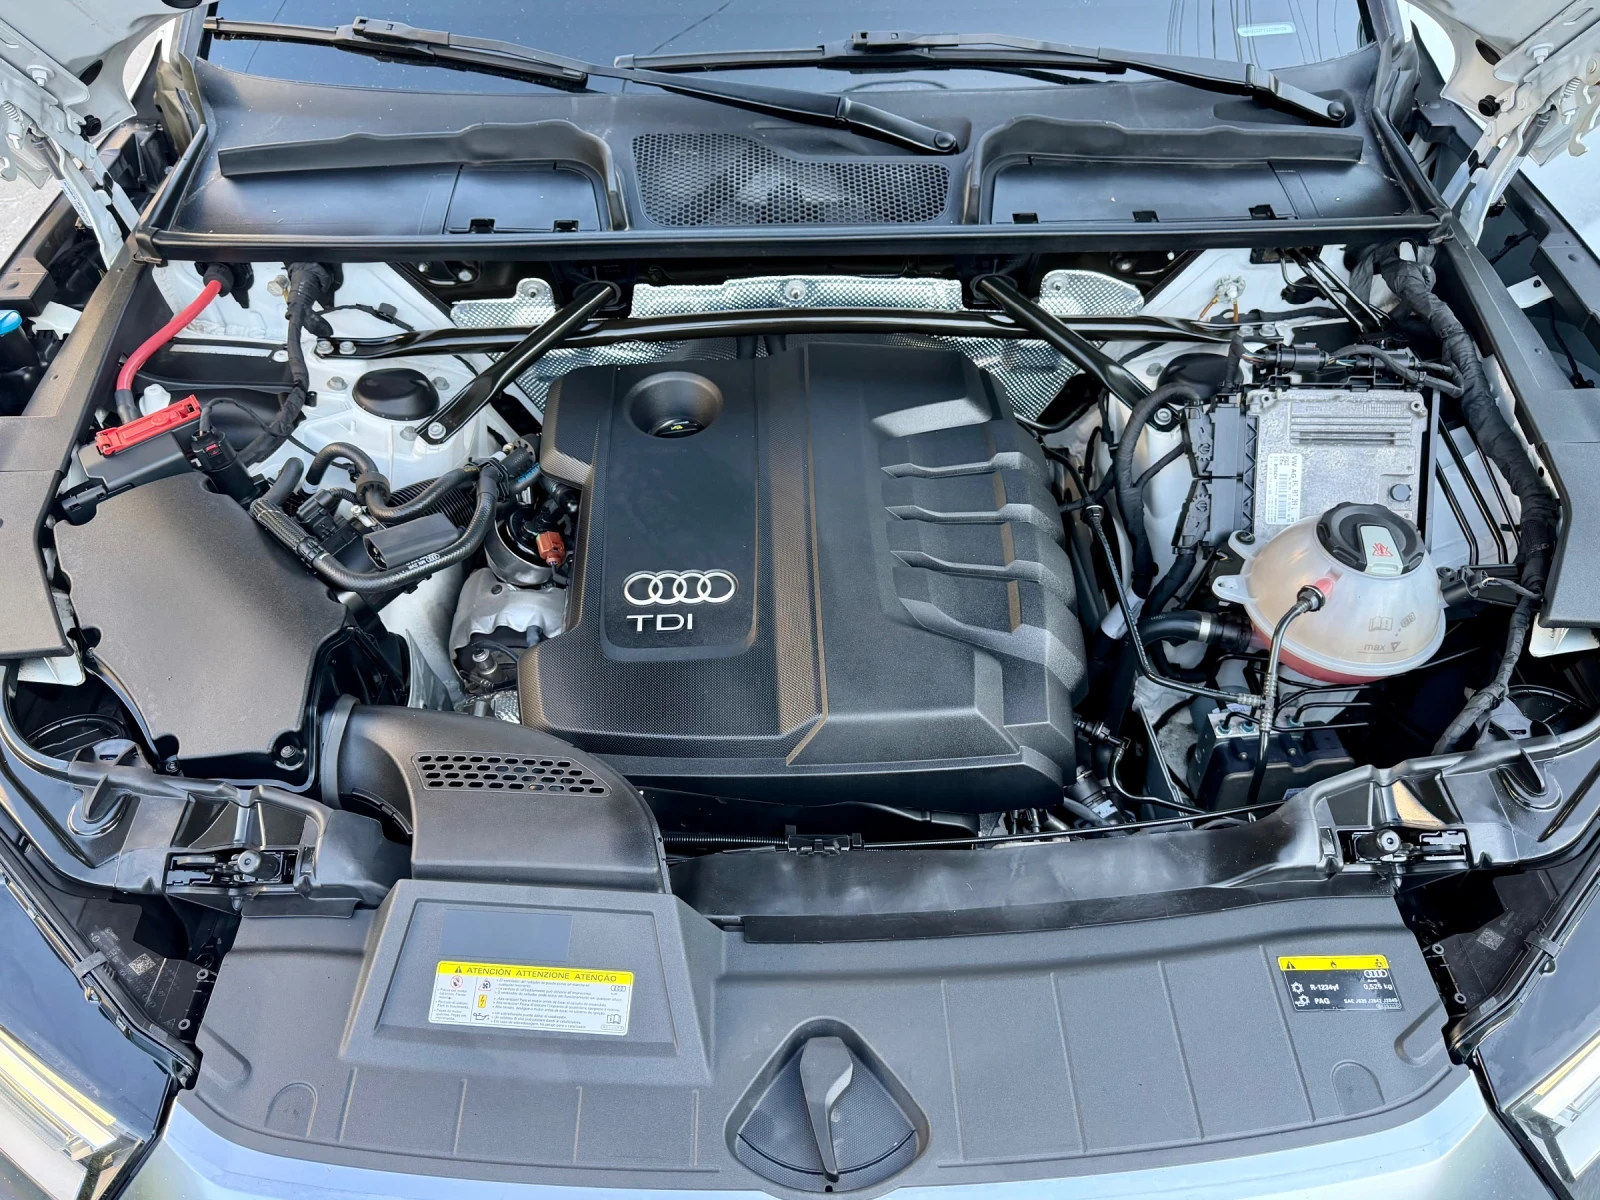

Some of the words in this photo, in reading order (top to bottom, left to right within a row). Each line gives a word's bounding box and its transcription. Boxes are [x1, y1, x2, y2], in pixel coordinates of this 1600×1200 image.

[626, 613, 693, 632] TDI
[1363, 643, 1386, 651] max
[466, 967, 512, 976] ATENCIÓN
[515, 969, 570, 979] ATTENZIONE
[574, 973, 617, 982] ATENÇÃO
